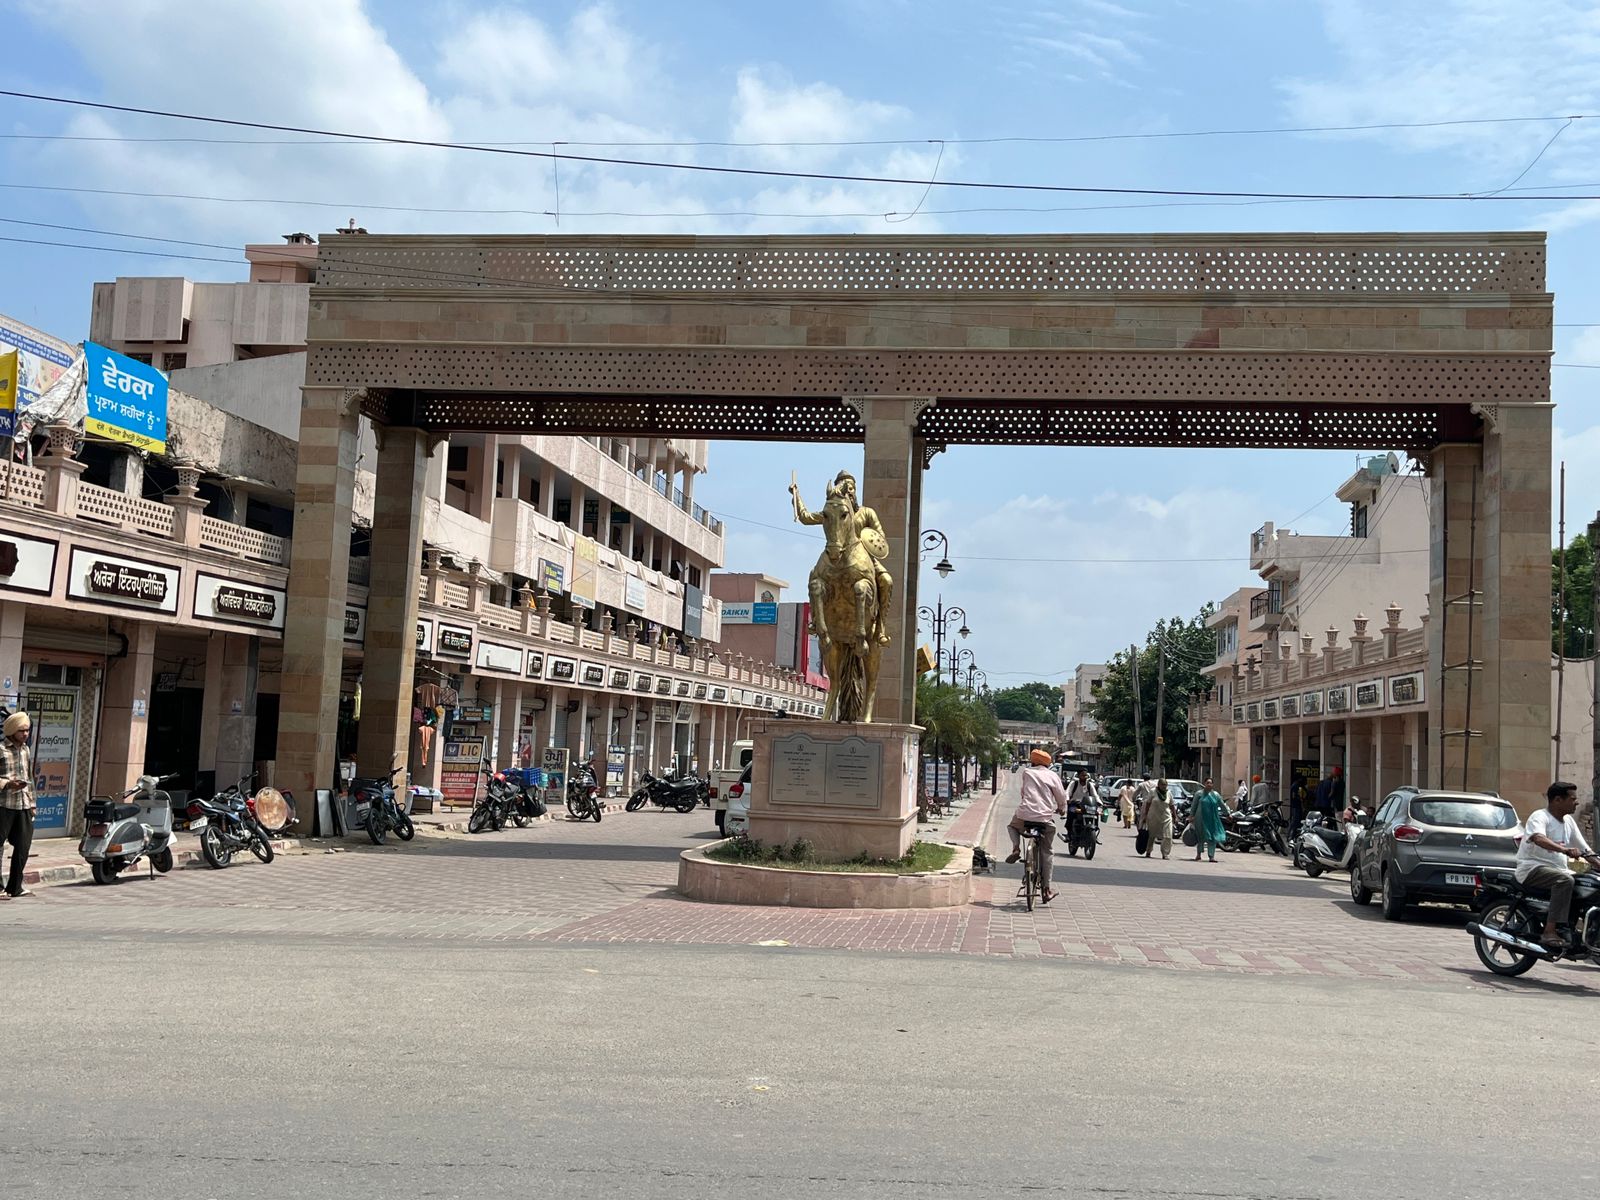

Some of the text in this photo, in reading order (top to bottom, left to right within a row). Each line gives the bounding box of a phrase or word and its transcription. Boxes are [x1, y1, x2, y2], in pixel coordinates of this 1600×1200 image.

[101, 356, 155, 401] ਵੇਰਕਾ
[93, 564, 117, 588] ਅਰੋੜਾ
[36, 702, 54, 710] UION
[461, 745, 478, 757] LIC
